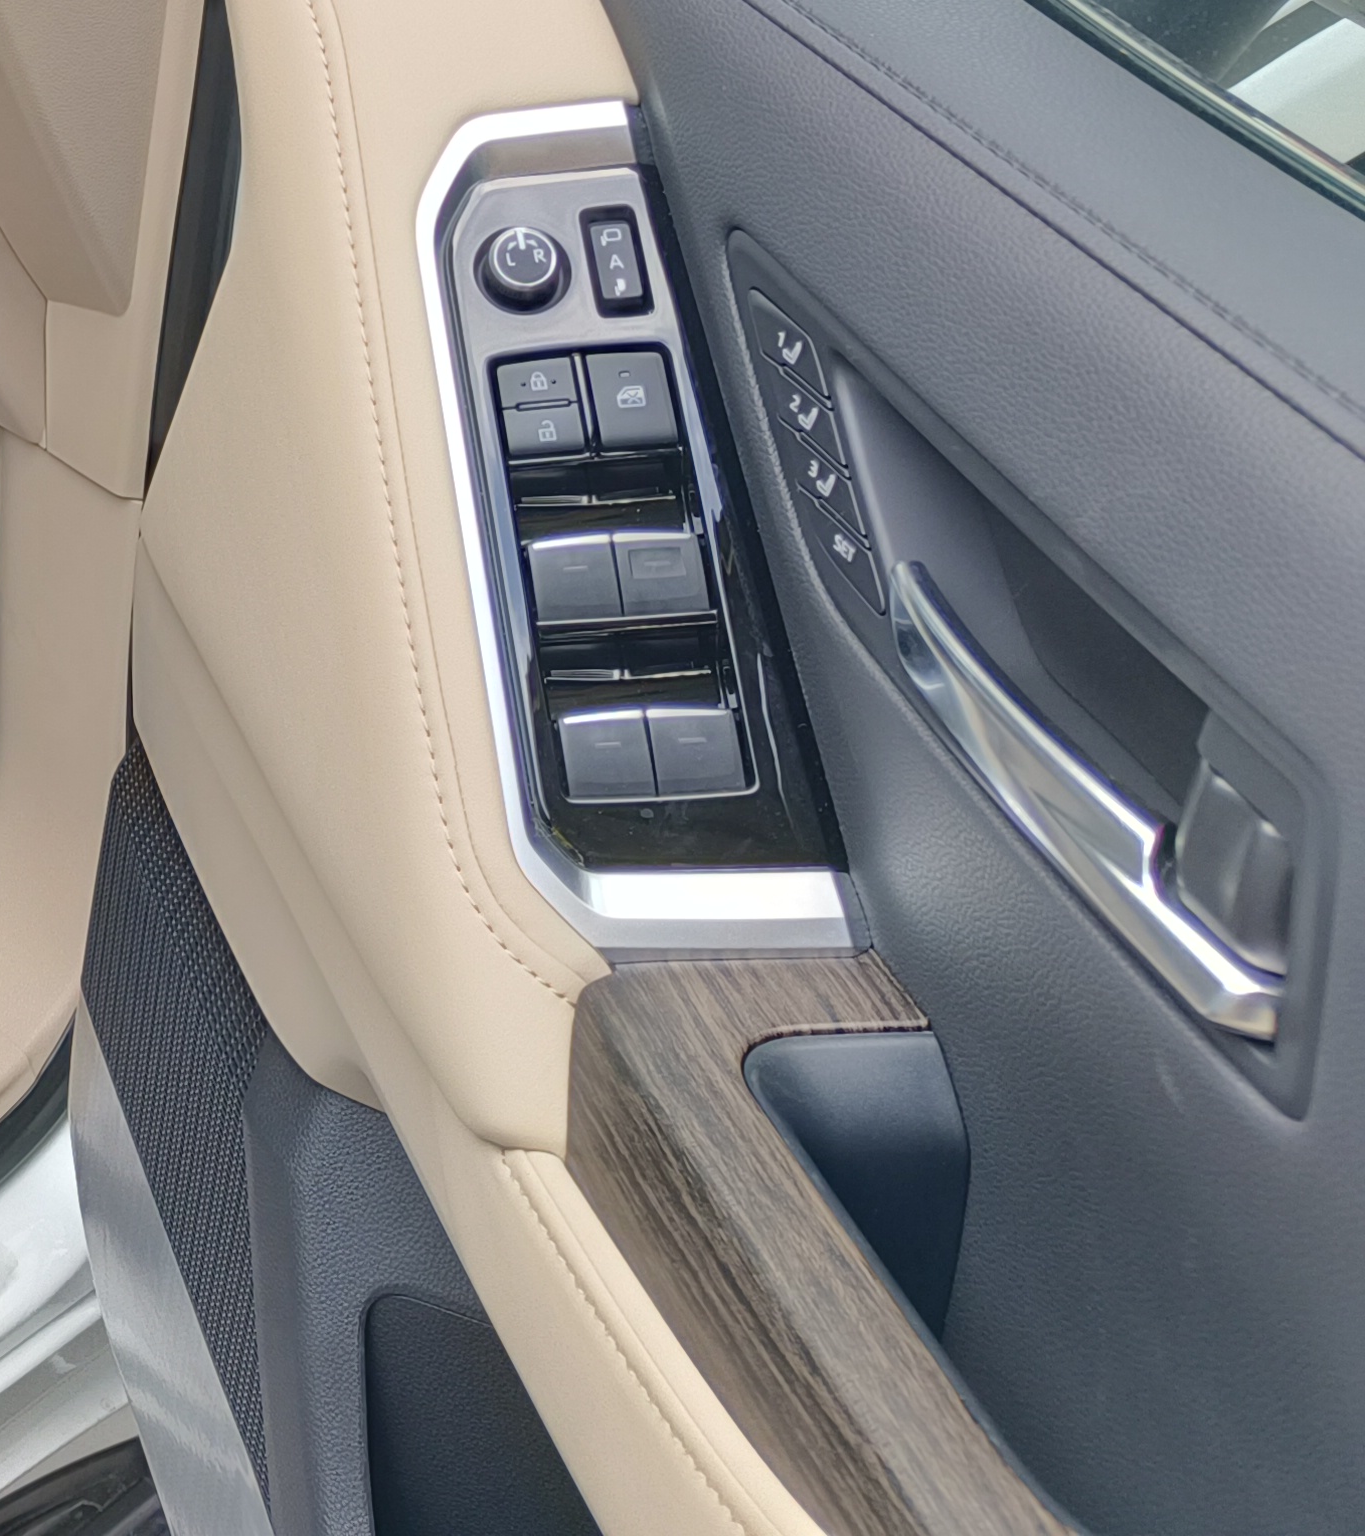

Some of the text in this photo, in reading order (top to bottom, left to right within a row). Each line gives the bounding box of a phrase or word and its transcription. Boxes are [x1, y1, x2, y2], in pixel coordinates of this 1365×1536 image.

[505, 248, 547, 266] L R
[609, 254, 625, 270] A
[777, 331, 786, 347] 1
[789, 394, 801, 413] 2
[807, 460, 819, 478] 3
[832, 534, 856, 563] SET
